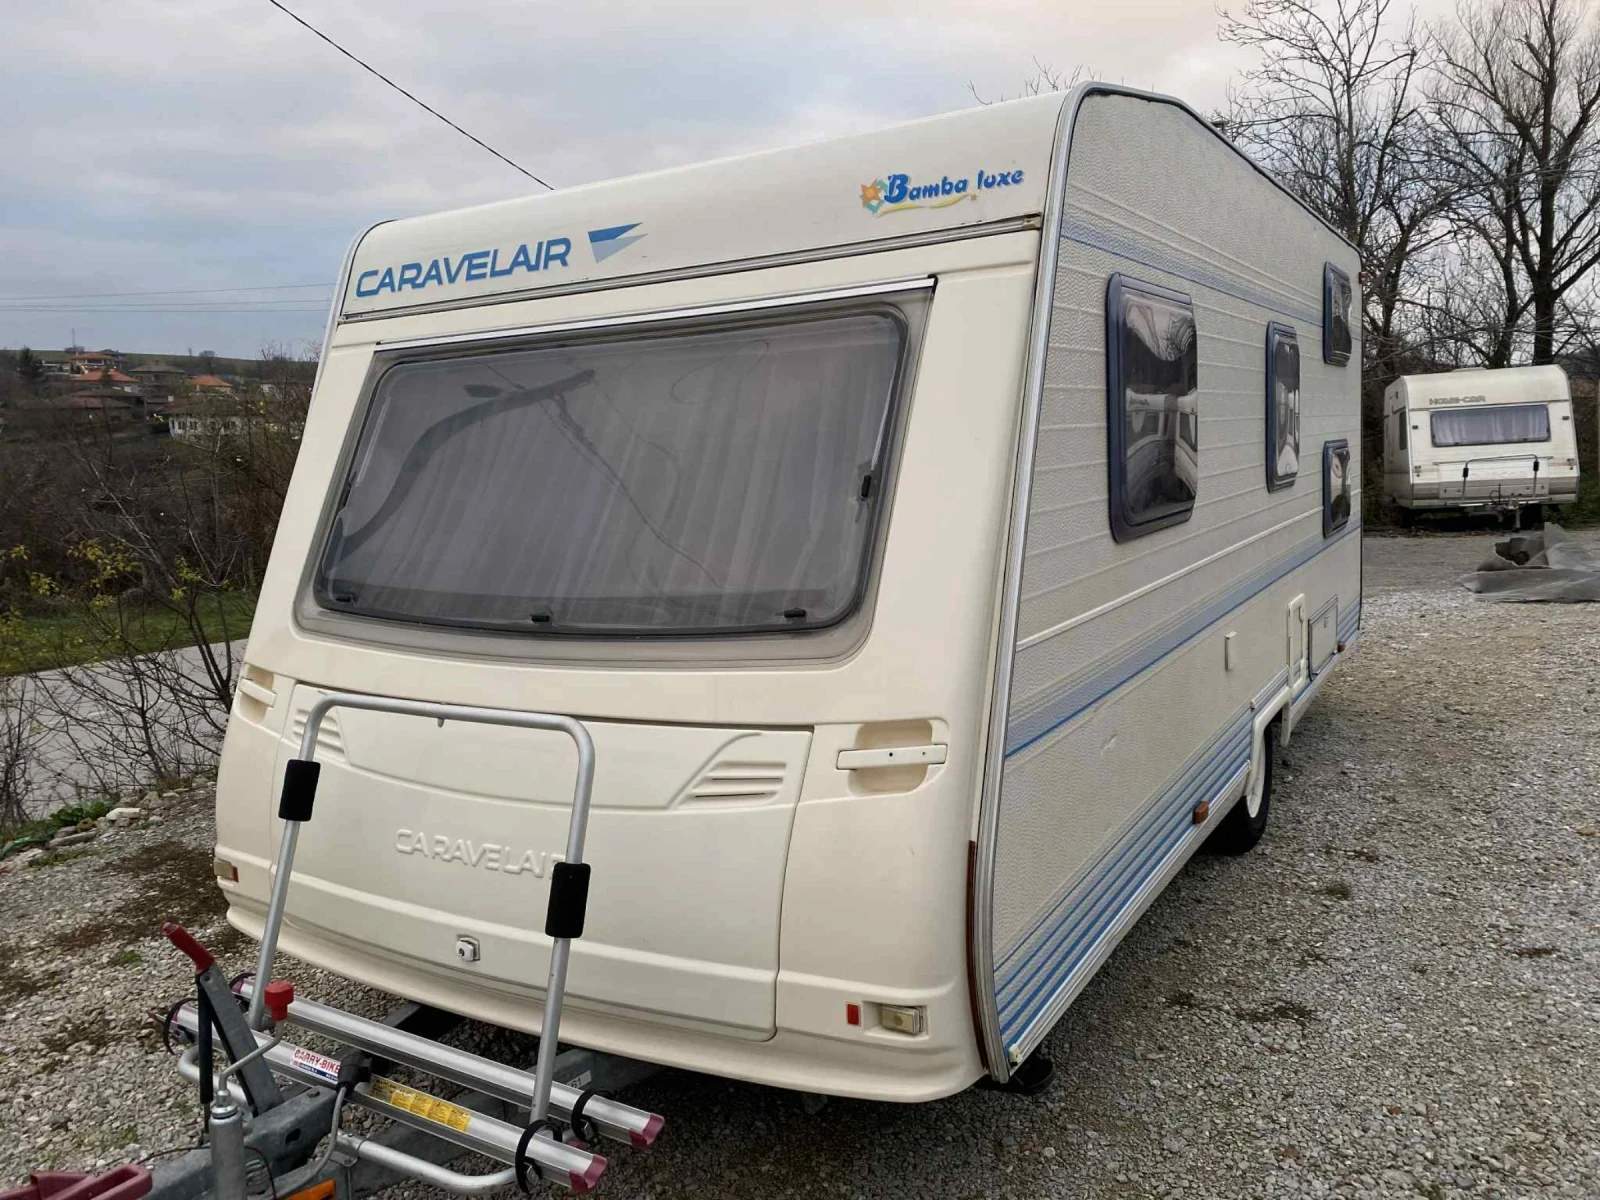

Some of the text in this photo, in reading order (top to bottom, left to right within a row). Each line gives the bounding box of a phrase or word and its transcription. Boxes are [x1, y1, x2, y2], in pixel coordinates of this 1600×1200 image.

[884, 170, 1024, 204] Bamba luxe
[356, 237, 572, 298] CARAVELAIR
